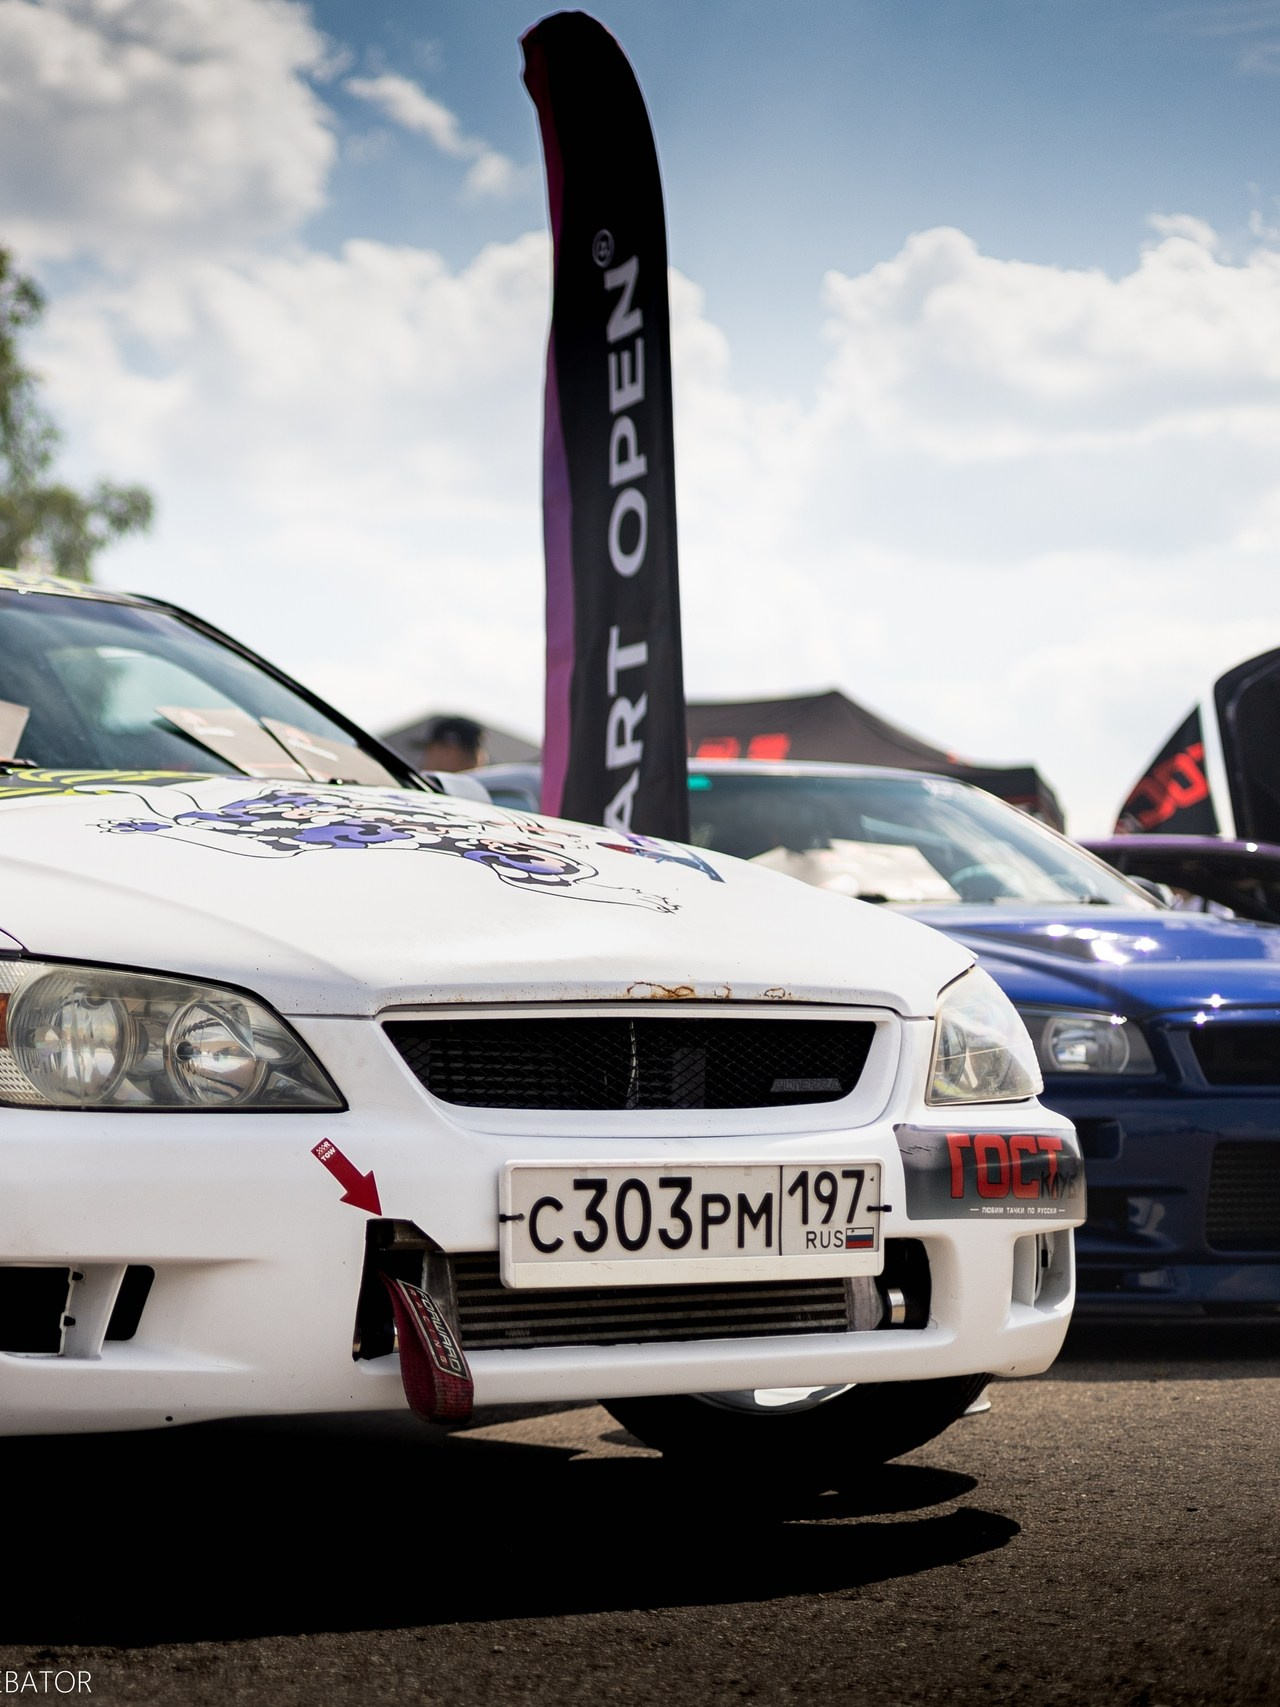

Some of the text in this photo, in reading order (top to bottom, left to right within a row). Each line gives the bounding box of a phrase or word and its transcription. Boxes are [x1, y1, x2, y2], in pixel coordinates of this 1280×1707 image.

[604, 254, 648, 577] OPEN
[320, 1147, 336, 1161] TOW
[946, 1133, 1062, 1200] ГОСТ
[787, 1169, 866, 1225] 197
[806, 1230, 844, 1249] RUS
[409, 1289, 448, 1366] RACING
[416, 1290, 462, 1373] FORWARD
